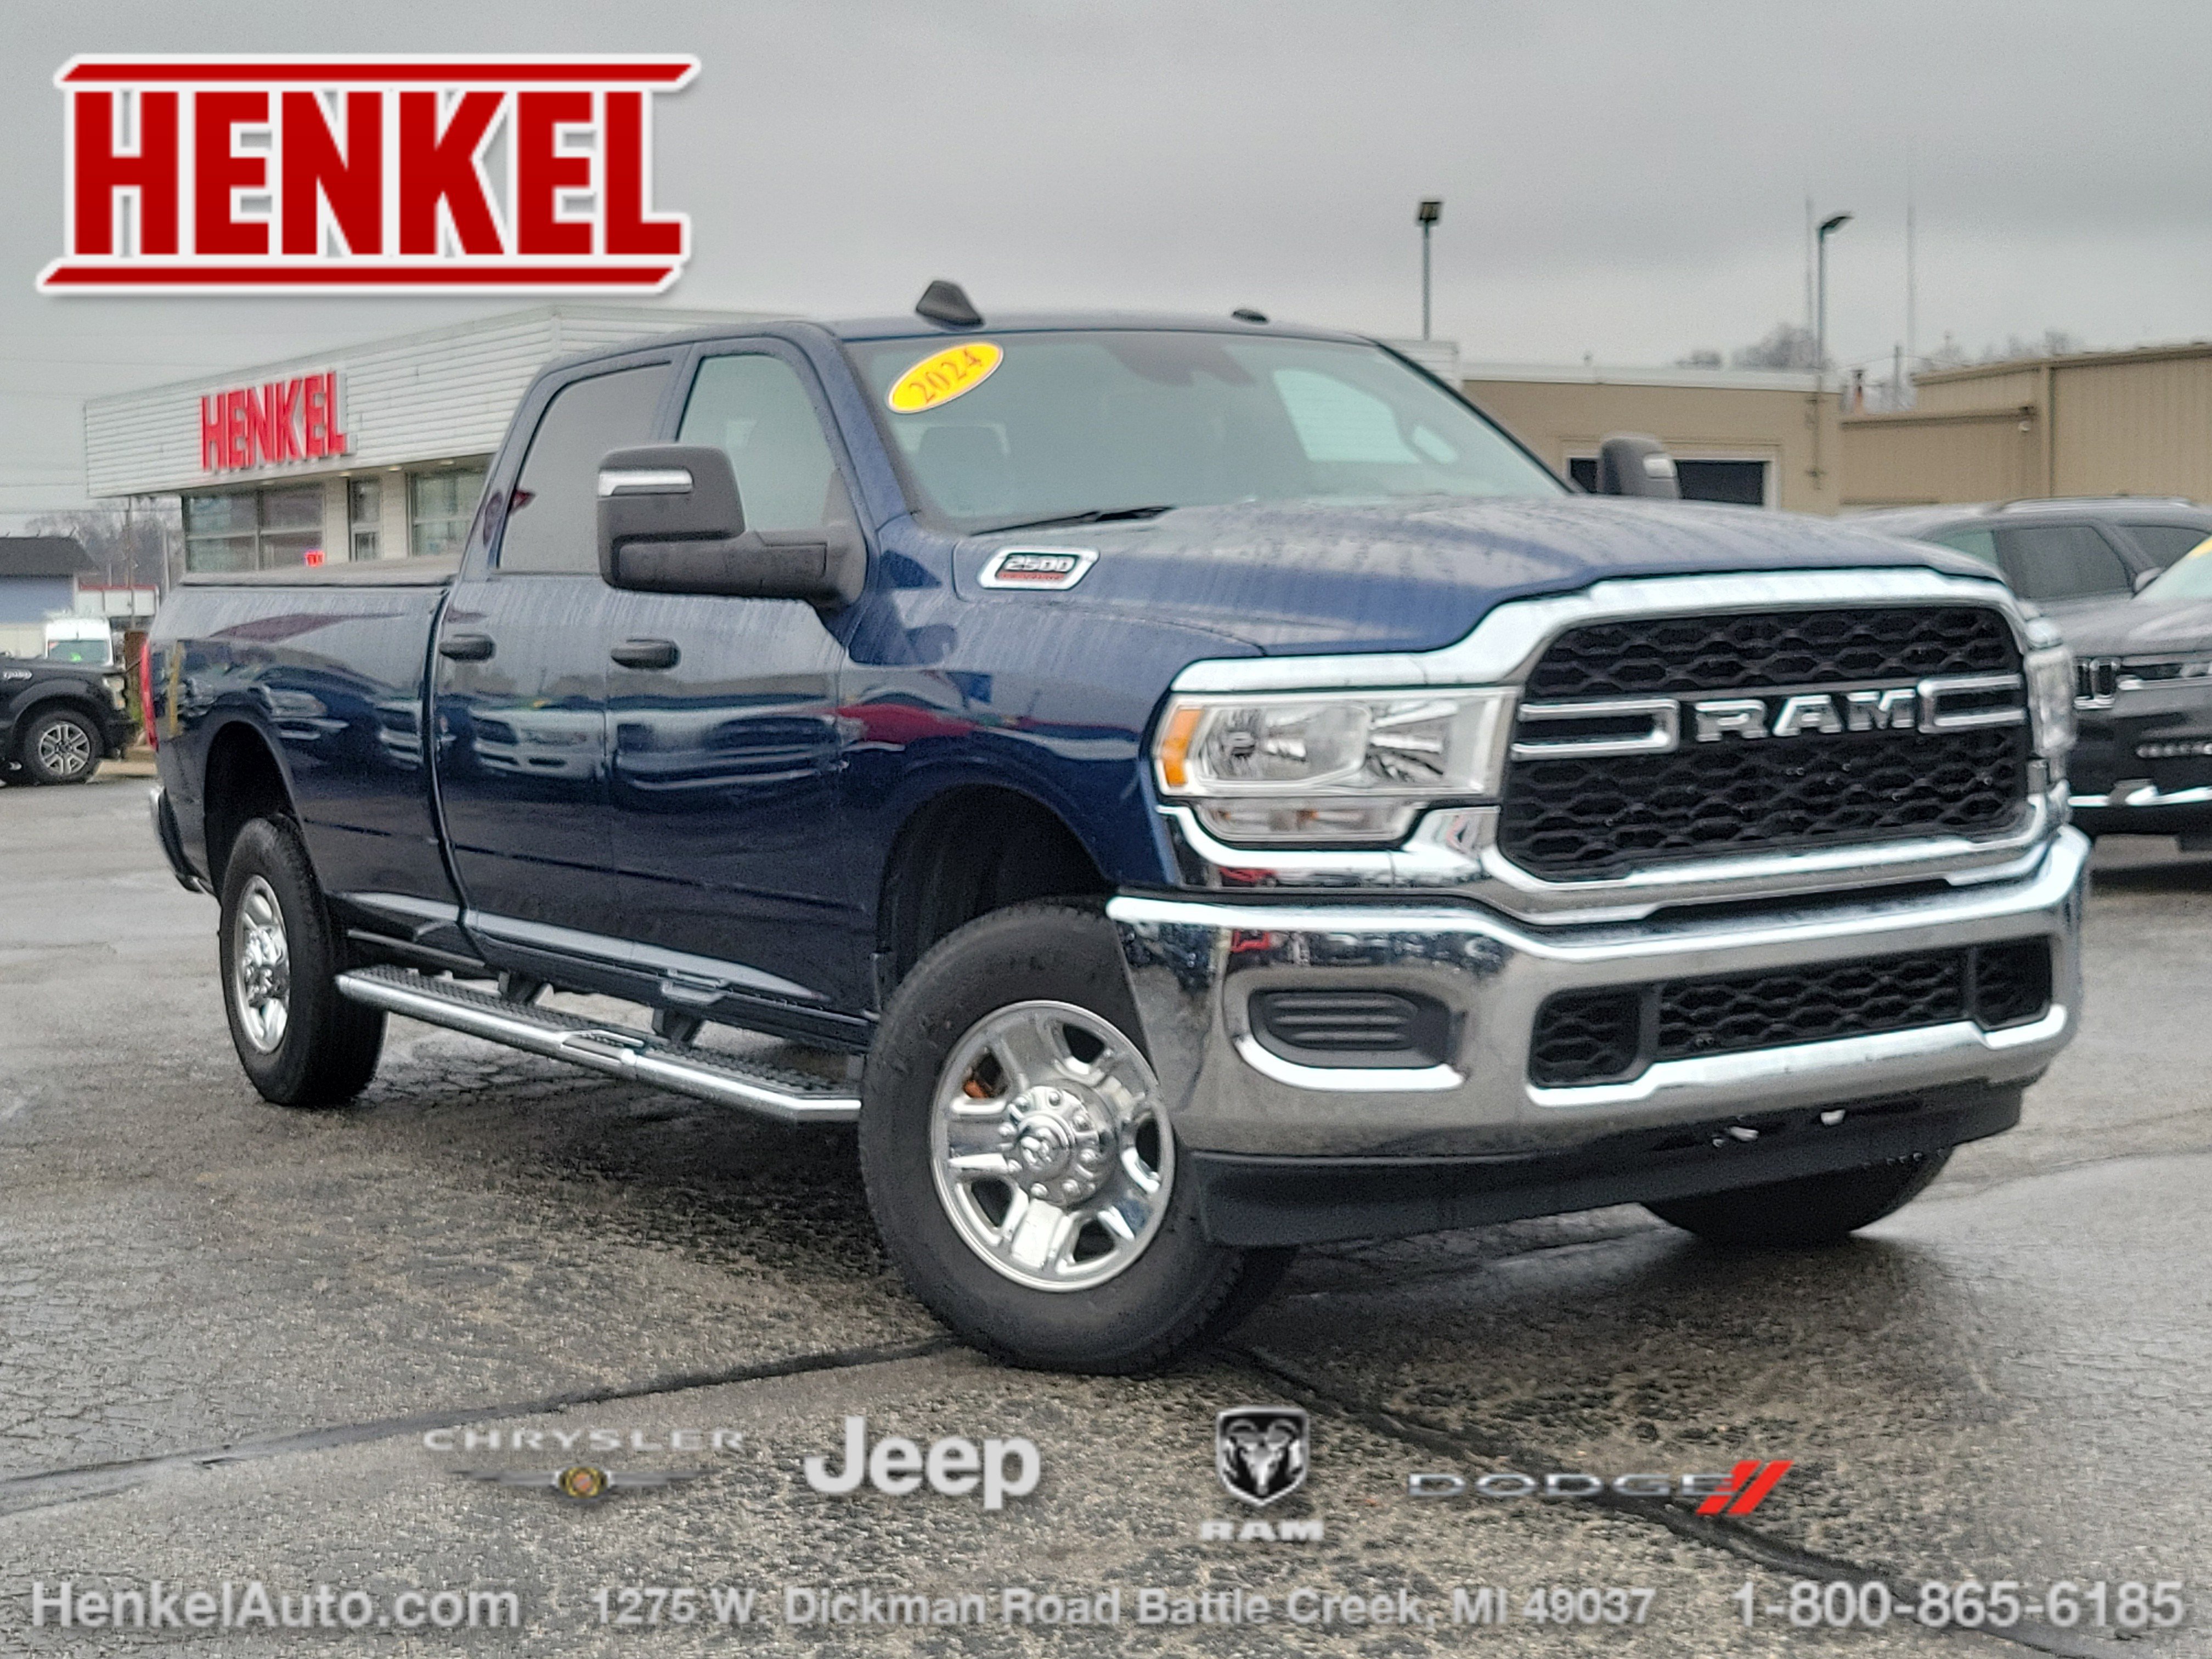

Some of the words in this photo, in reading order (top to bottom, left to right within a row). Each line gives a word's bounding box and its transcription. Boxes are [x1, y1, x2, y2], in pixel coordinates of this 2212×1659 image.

[909, 347, 983, 404] 2024
[201, 370, 347, 472] HENKEL
[1005, 554, 1076, 572] 2500
[1695, 689, 1916, 742] RAM
